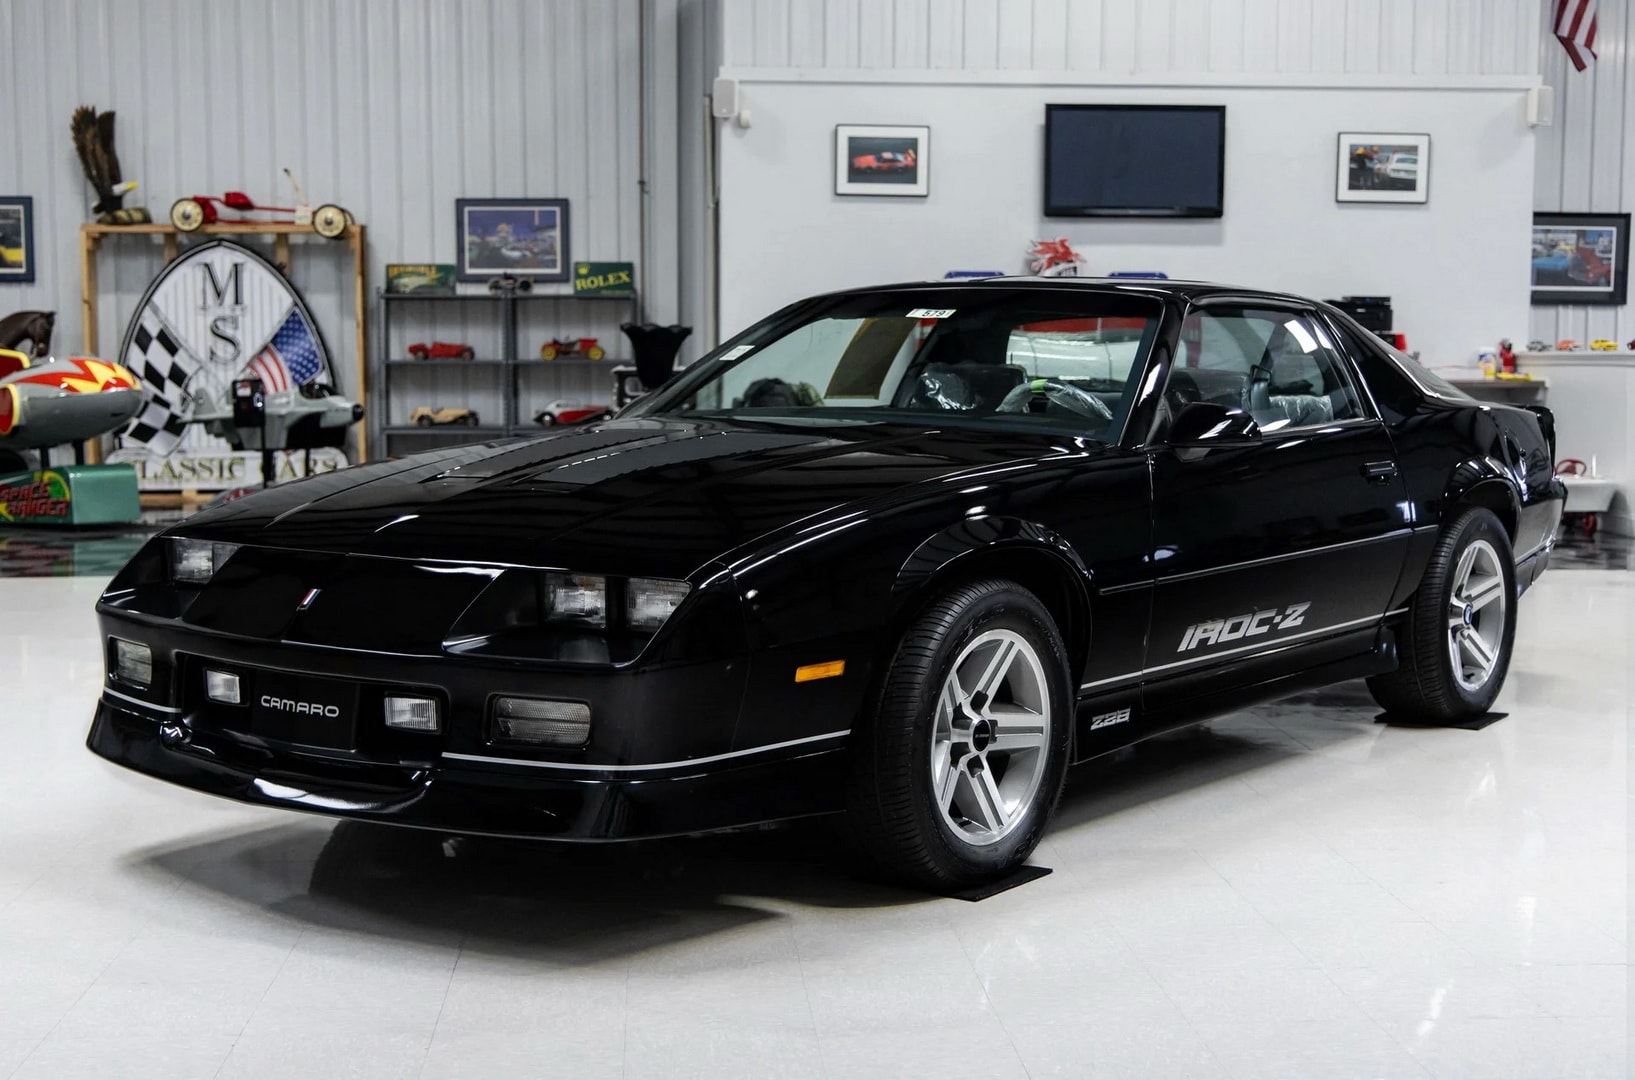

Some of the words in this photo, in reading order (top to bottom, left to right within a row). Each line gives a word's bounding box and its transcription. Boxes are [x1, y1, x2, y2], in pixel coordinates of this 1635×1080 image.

[197, 262, 247, 310] M
[575, 271, 631, 290] ROLEX
[209, 316, 241, 363] S
[123, 456, 246, 481] LASSIC
[7, 500, 68, 517] RANGER
[1177, 601, 1312, 653] IROC-Z
[261, 695, 339, 717] CAMARO
[1090, 708, 1131, 730] Z28
